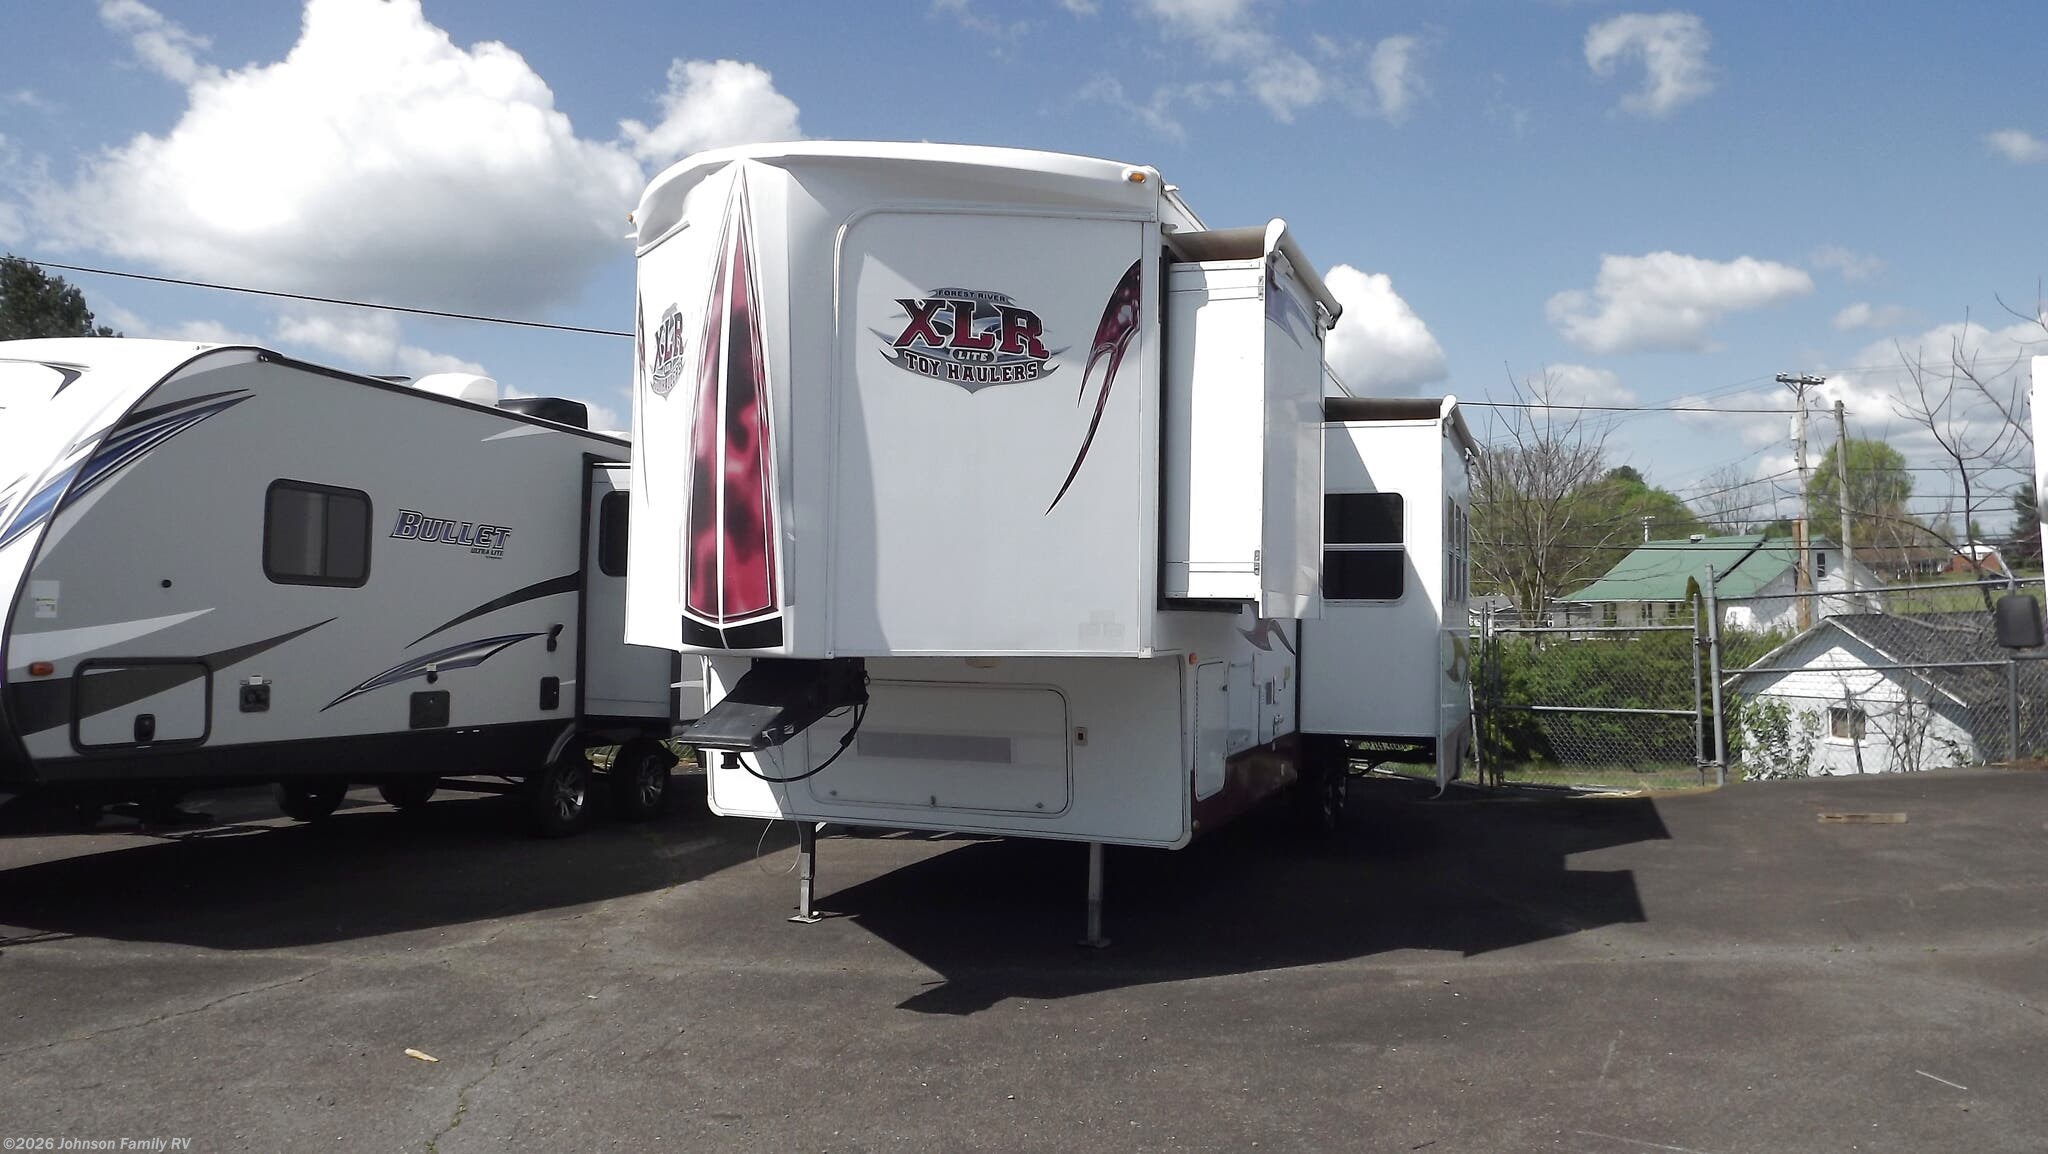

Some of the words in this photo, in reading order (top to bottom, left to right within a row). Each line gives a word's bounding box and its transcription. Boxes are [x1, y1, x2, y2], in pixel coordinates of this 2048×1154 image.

[938, 289, 975, 298] FOREST
[978, 292, 1006, 302] RIVER
[653, 311, 685, 374] XLR
[892, 298, 1050, 361] XLR
[904, 351, 942, 377] TOY
[947, 361, 1039, 384] HAULERS
[957, 350, 989, 363] LITE
[389, 508, 512, 550] BULLET
[490, 549, 504, 557] LITE
